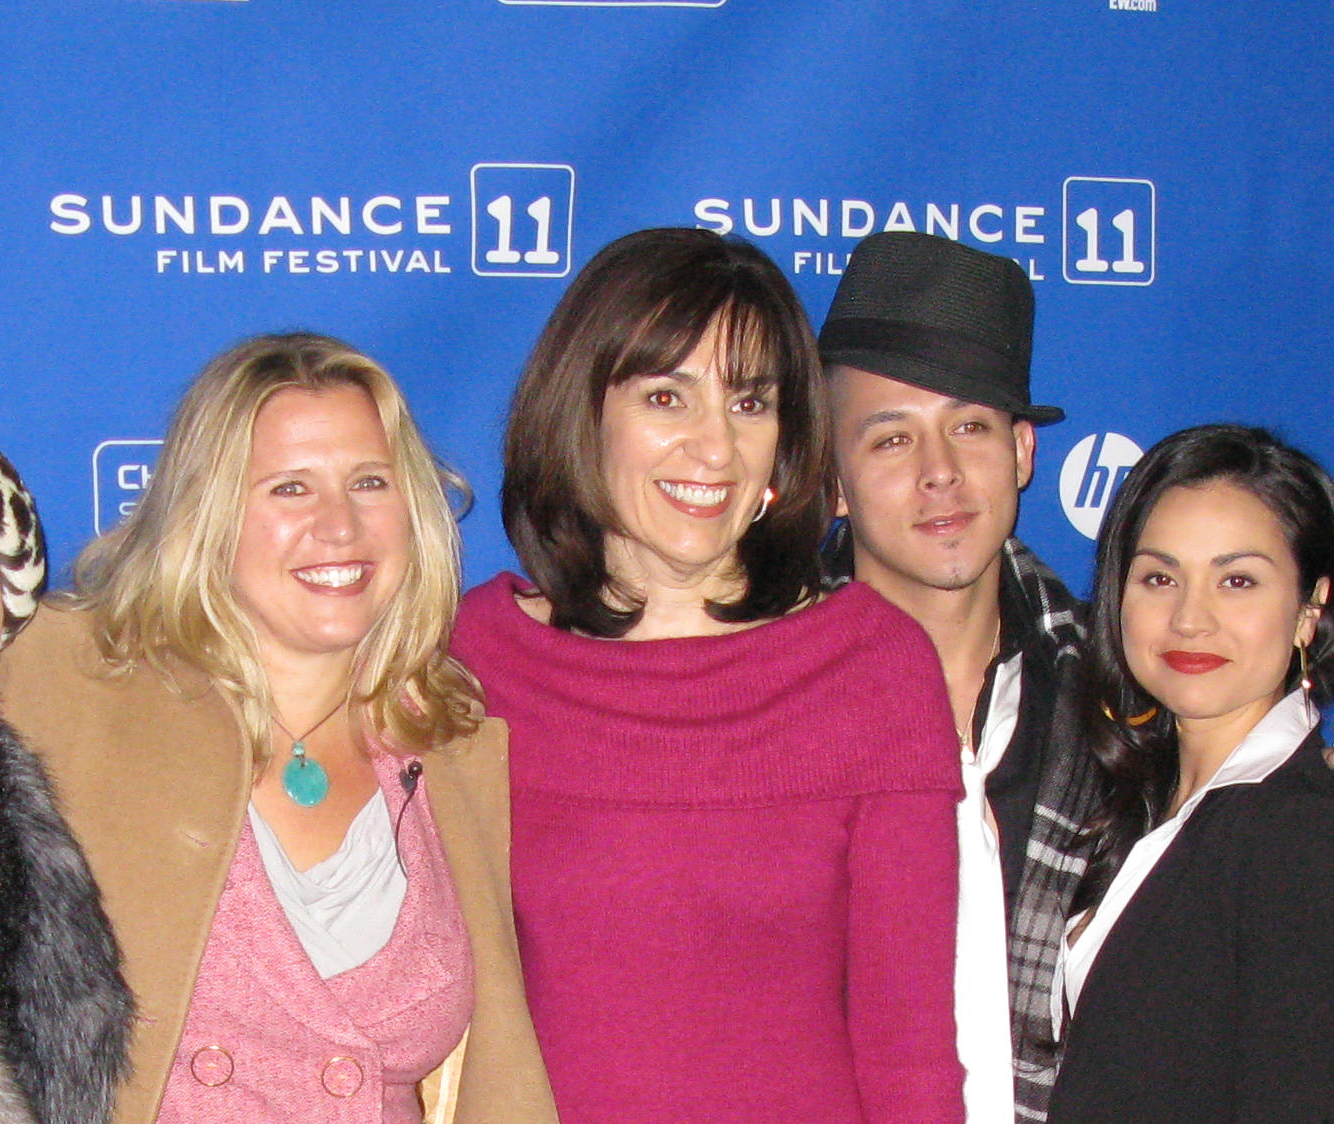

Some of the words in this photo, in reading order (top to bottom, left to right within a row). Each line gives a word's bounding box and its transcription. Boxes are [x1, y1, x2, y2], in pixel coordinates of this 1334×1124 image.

[49, 193, 452, 236] SUNDANCE
[485, 194, 560, 265] 11
[694, 198, 1046, 244] SUNDANCE
[156, 250, 245, 274] FILM
[264, 250, 451, 274] FESTIVAL
[1075, 207, 1145, 274] 11
[793, 251, 852, 276] FIL
